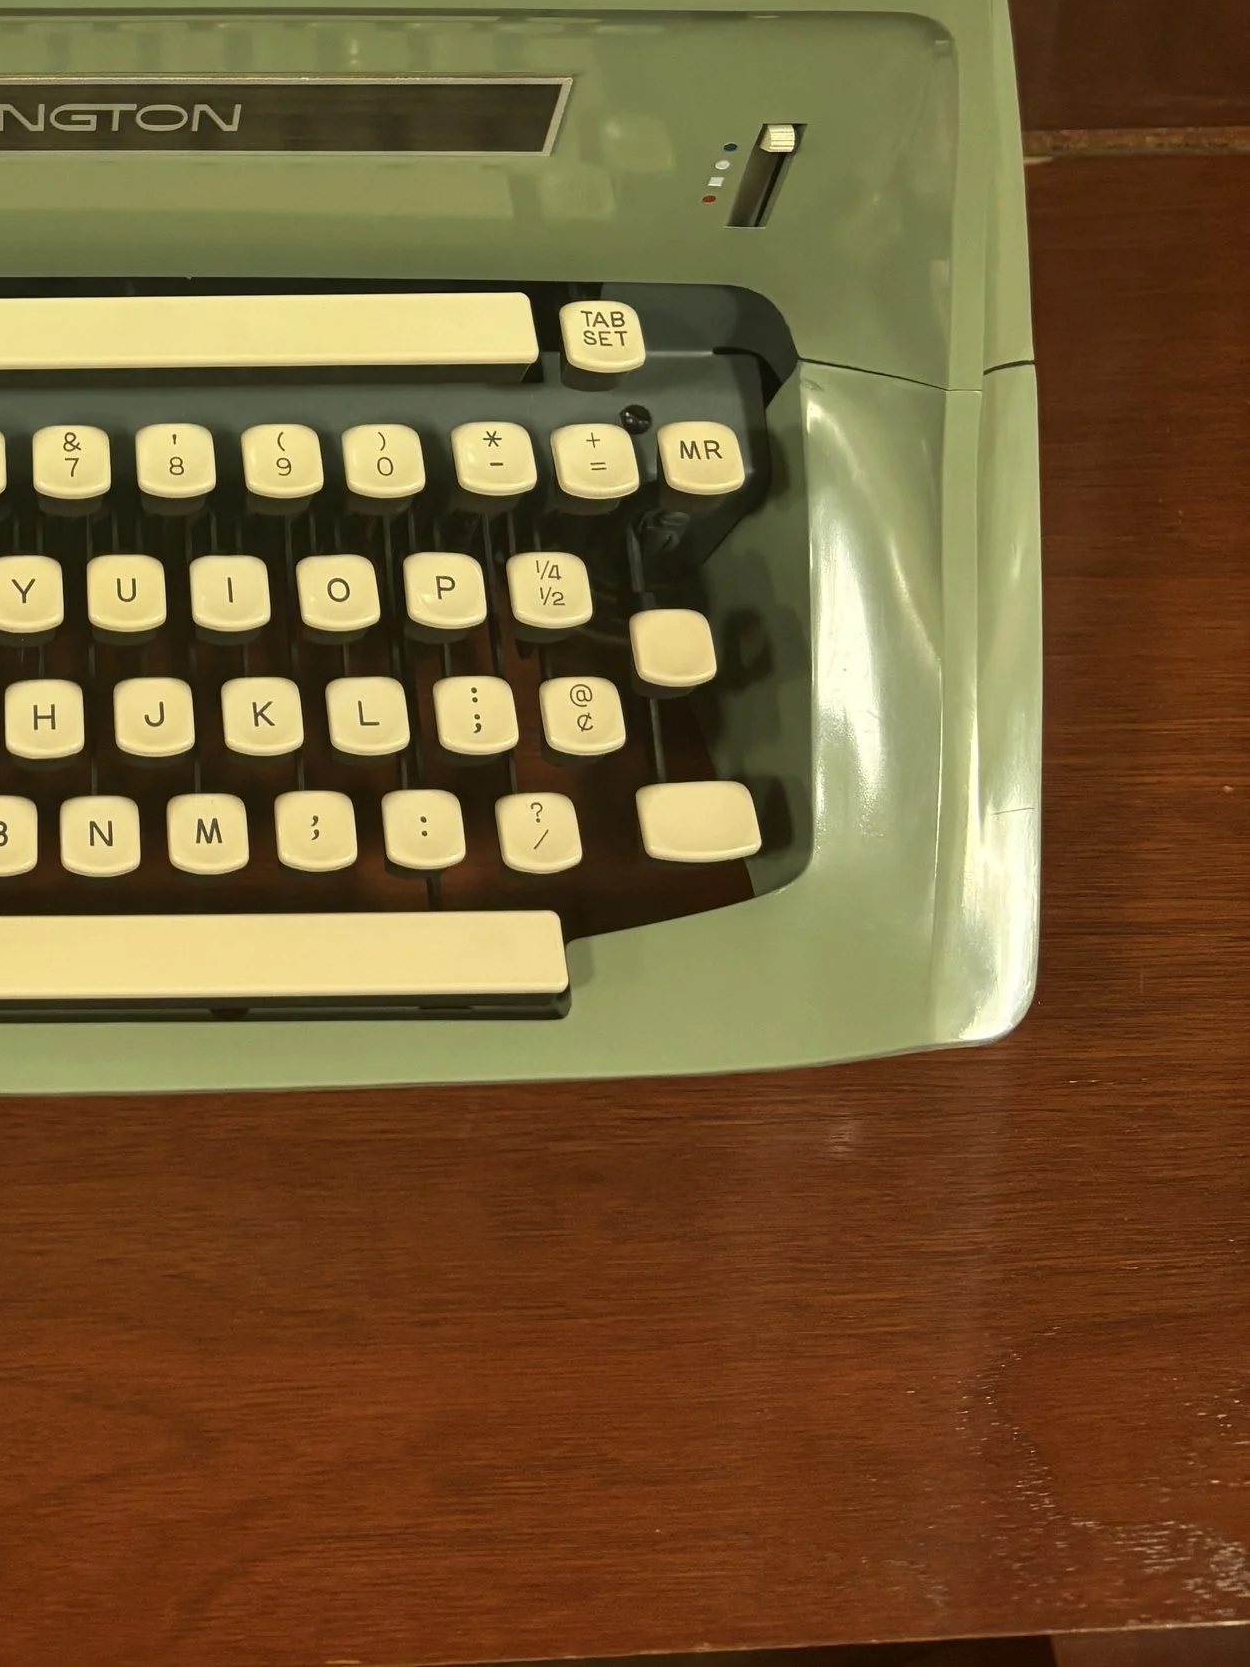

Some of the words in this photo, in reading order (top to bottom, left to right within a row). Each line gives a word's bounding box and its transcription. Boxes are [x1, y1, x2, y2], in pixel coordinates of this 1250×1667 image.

[580, 309, 627, 328] TAB
[583, 330, 628, 348] SET
[62, 431, 82, 453] &
[679, 439, 723, 460] MR
[64, 457, 80, 478] 7
[169, 456, 185, 476] 8
[276, 457, 292, 477] 9
[11, 578, 36, 604] Y
[116, 577, 137, 603] U
[327, 577, 351, 603] O
[435, 575, 456, 600] P
[33, 703, 56, 731] H
[144, 701, 165, 728] J
[252, 701, 276, 728] K
[357, 700, 380, 727] L
[89, 820, 114, 847] N
[195, 817, 223, 845] M
